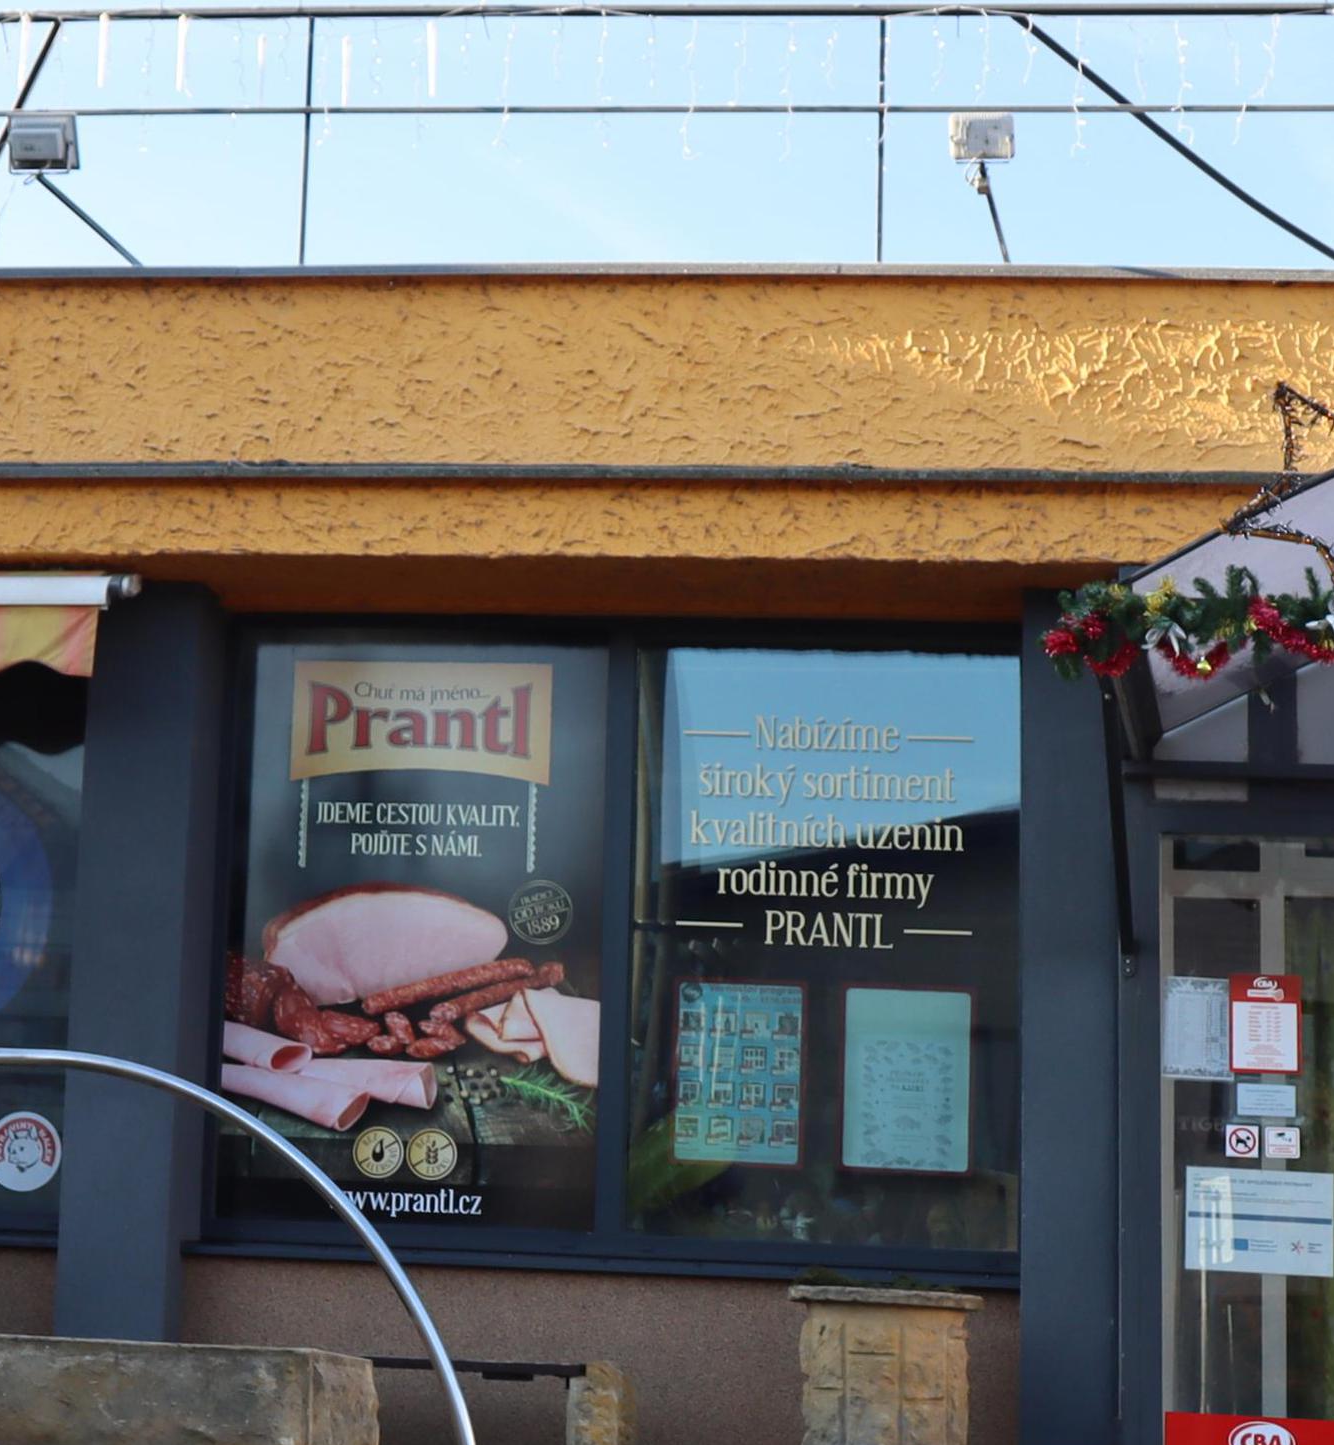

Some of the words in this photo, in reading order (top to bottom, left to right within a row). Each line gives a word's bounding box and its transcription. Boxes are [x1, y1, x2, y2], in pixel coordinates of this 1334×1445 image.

[400, 685, 425, 701] má
[305, 680, 534, 759] Prantl
[755, 715, 900, 753] Nabízíme
[698, 762, 797, 807] široký
[803, 765, 957, 803] sortiment
[316, 801, 373, 825] JDEME
[376, 802, 442, 826] CESTOU
[689, 810, 847, 848] kvalitních
[855, 816, 965, 852] uzenin
[351, 829, 412, 856] POJĎTE
[415, 833, 427, 857] S
[431, 830, 482, 858] NÁMI.
[717, 860, 839, 898] rodinné
[846, 862, 935, 909] firmy
[526, 914, 560, 936] 1889
[764, 909, 894, 950] PRANTL
[343, 1188, 482, 1218] ww.prantl.cz
